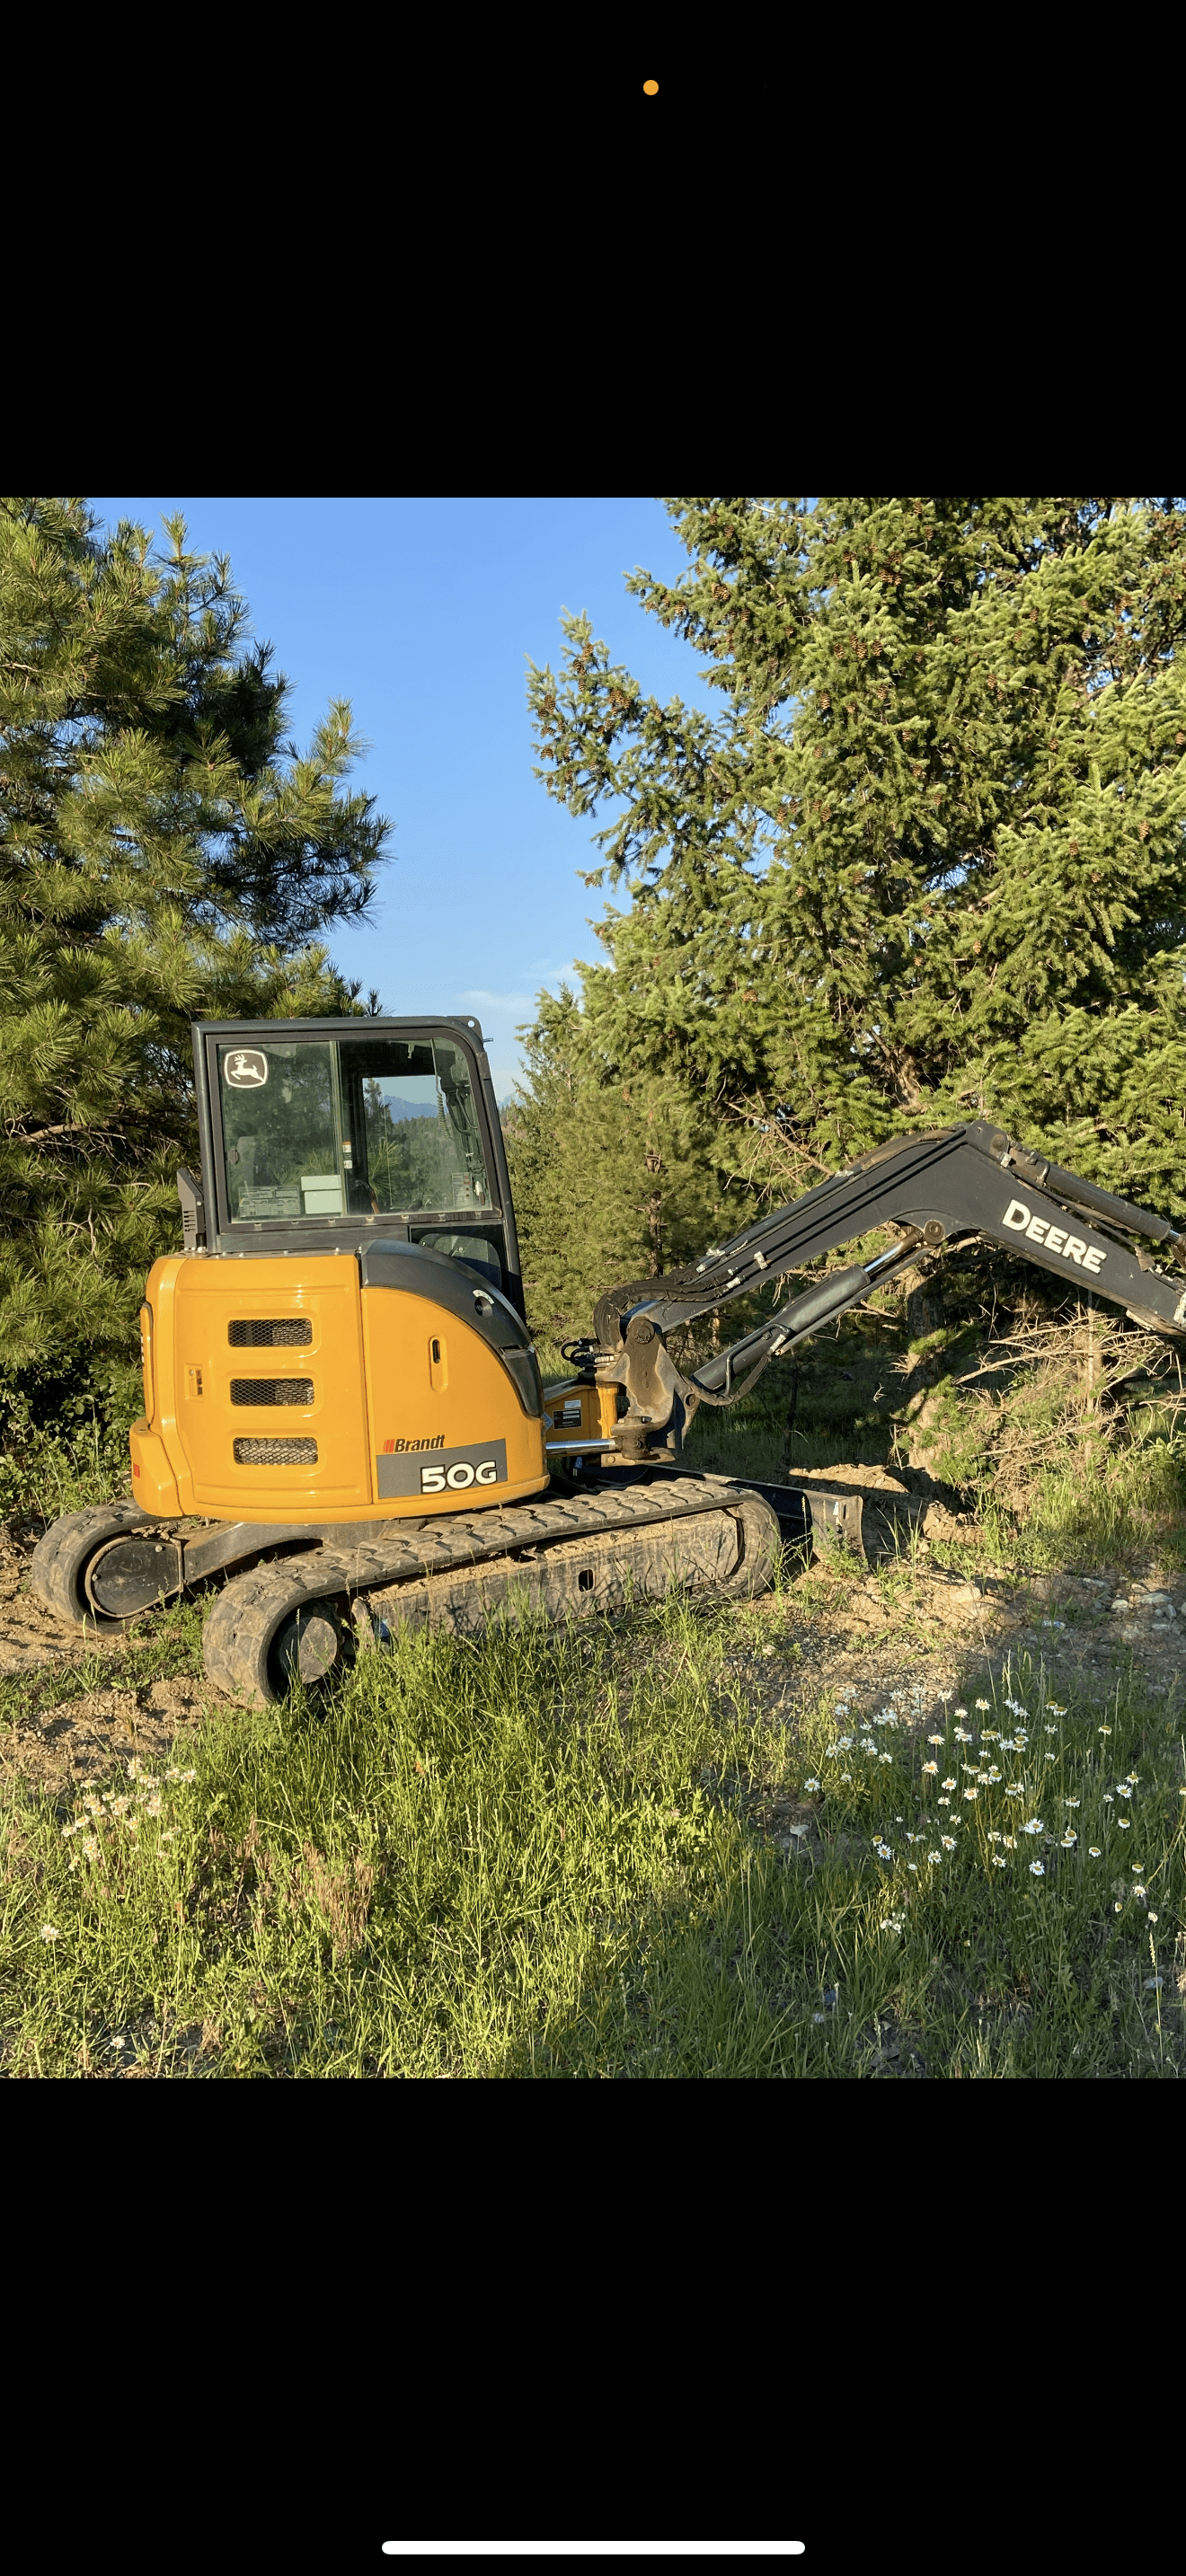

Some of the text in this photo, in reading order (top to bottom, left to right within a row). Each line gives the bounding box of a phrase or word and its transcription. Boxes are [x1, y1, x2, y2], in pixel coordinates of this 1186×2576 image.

[1002, 1199, 1107, 1274] DEERE
[394, 1434, 445, 1452] Brandt
[420, 1460, 497, 1494] 50G
